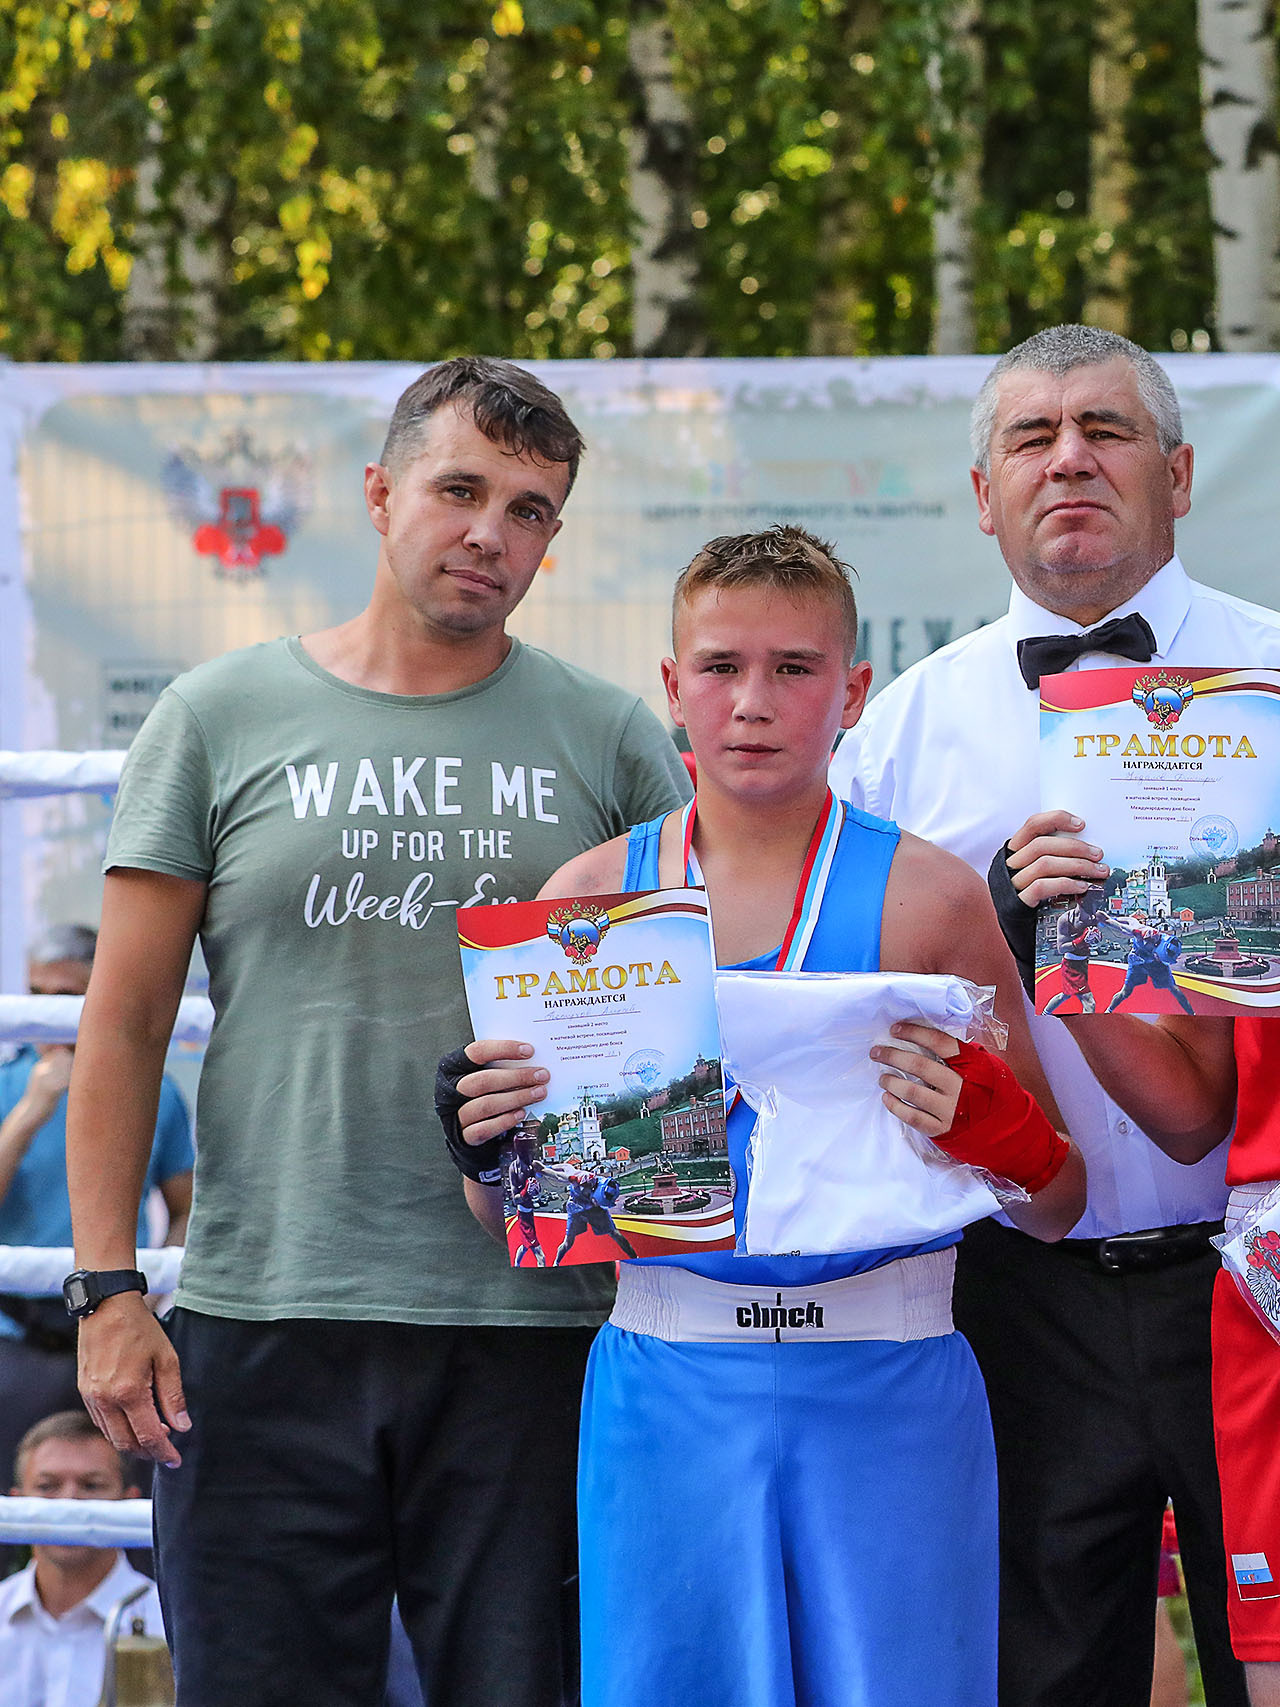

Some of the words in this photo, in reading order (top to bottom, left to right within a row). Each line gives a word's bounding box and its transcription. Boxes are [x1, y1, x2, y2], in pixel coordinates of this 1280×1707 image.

[1074, 733, 1258, 759] ГРАМОТА
[1123, 761, 1203, 770] НАГРАЖДАЕТСЯ
[285, 756, 463, 819] WAKE
[491, 761, 560, 824] ME
[342, 829, 379, 859] UP
[392, 830, 445, 861] FOR
[459, 829, 513, 859] THE
[494, 960, 681, 1000] ГРАМОТА
[544, 993, 627, 1009] НАГРАЖДАЕТСЯ
[736, 1301, 824, 1328] clinch
